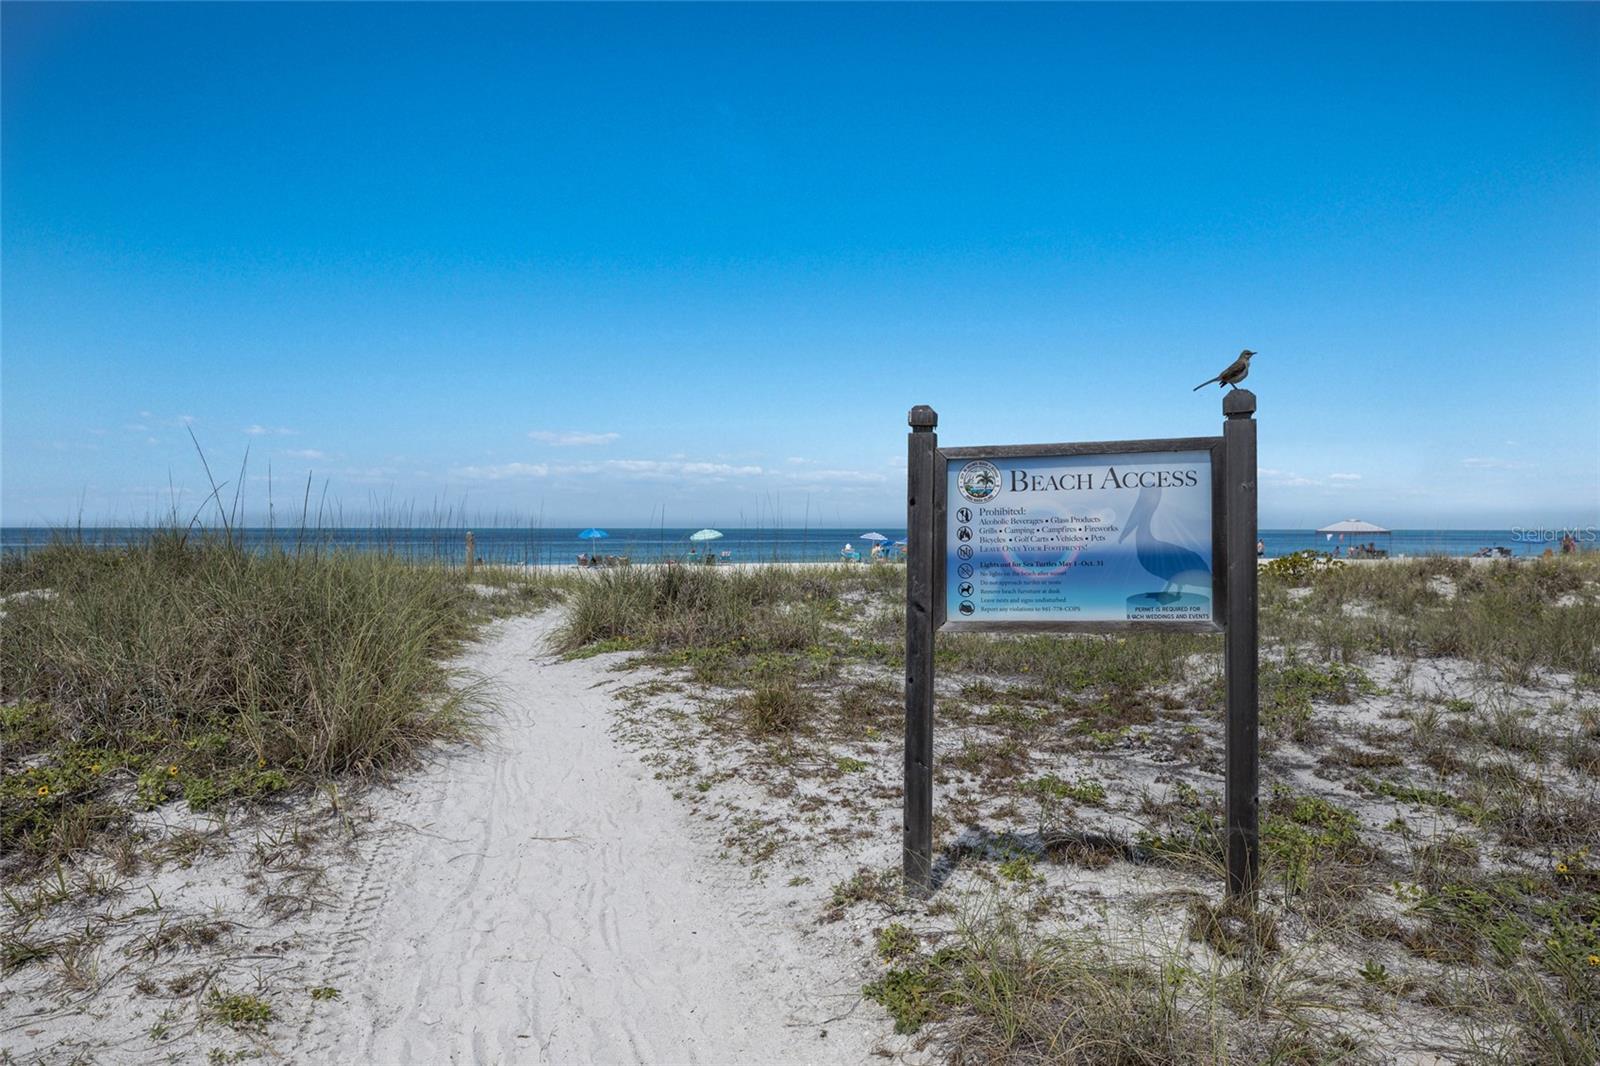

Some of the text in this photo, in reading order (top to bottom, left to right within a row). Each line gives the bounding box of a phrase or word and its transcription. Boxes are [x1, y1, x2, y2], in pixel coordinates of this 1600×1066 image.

[980, 507, 1026, 516] Prohibited:
[1004, 526, 1035, 535] Camping
[1058, 560, 1072, 569] May
